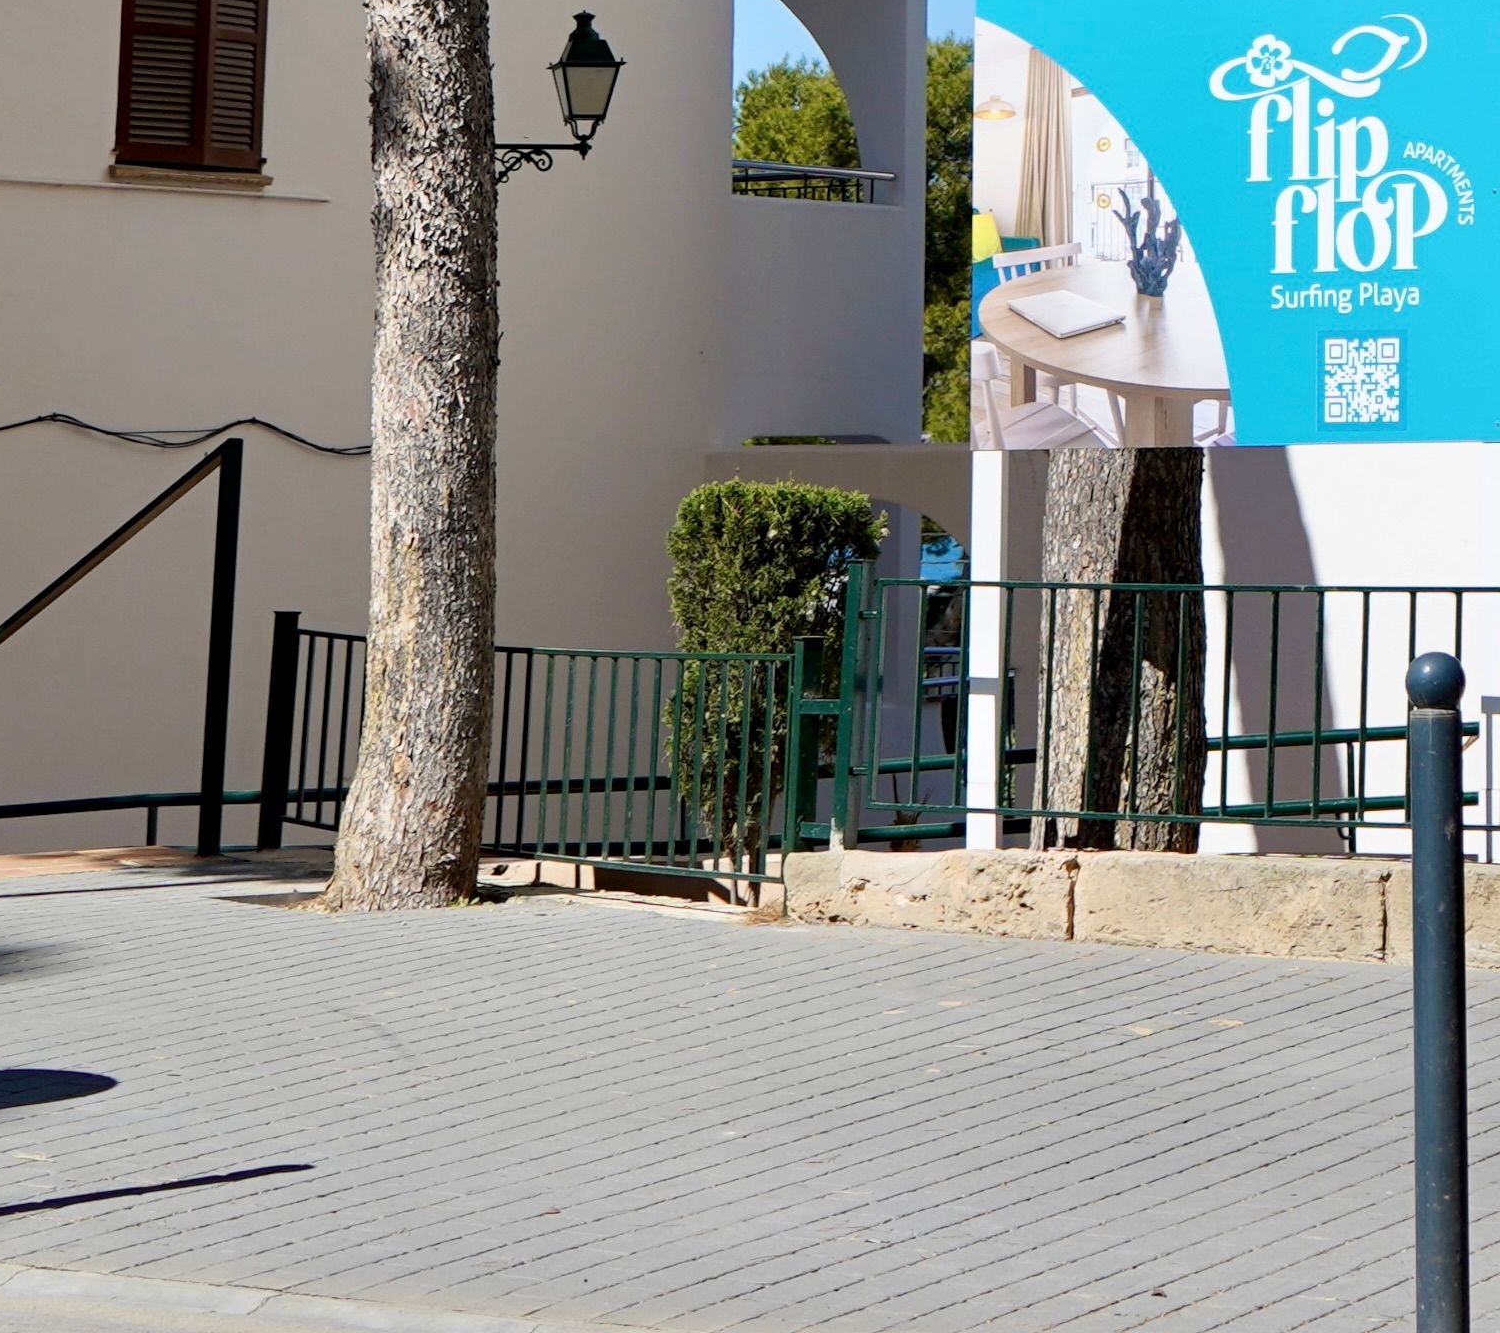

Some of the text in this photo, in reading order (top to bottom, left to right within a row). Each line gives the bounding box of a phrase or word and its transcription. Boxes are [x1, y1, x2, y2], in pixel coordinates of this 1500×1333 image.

[1246, 80, 1389, 202] flip
[1403, 141, 1475, 225] APARTMENTS
[1271, 282, 1420, 313] Surfing Playa
